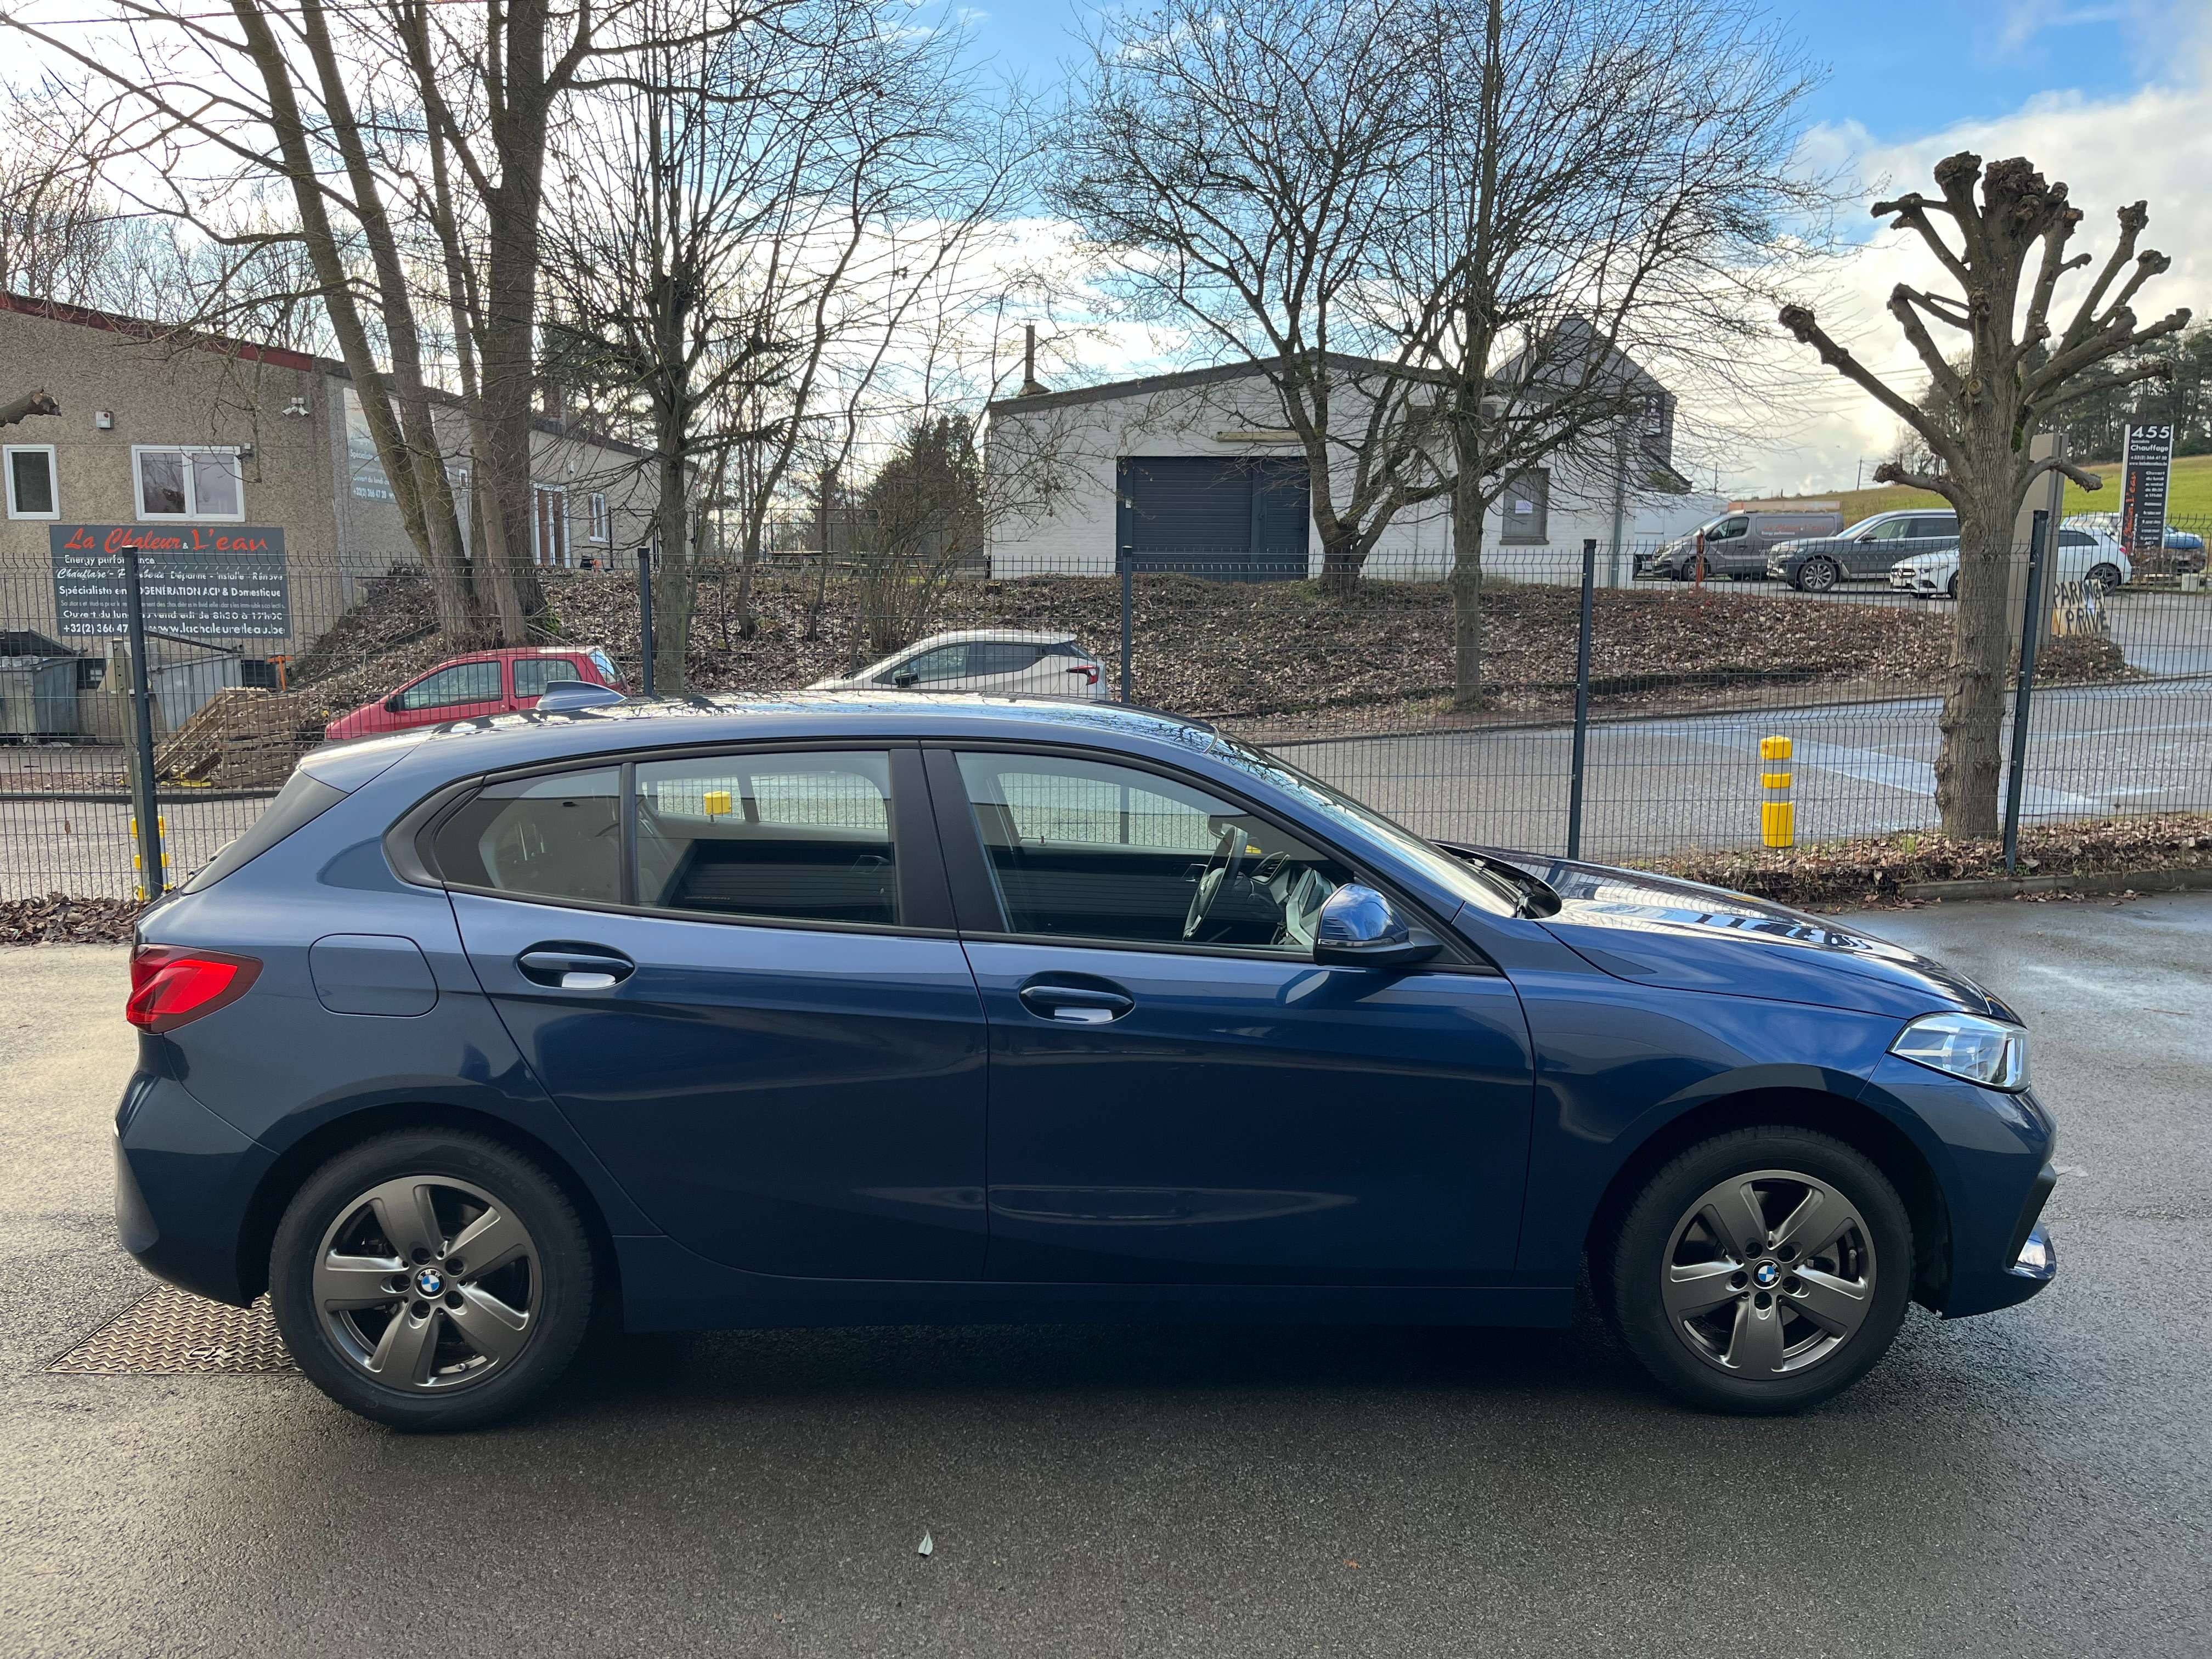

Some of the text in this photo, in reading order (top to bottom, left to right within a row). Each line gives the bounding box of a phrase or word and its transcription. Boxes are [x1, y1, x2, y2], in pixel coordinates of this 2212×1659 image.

[2131, 426, 2170, 439] 455
[2130, 444, 2169, 453] Chauffage
[367, 488, 375, 498] 366
[375, 489, 381, 498] 47
[64, 528, 95, 549] La
[105, 528, 181, 553] Chaleur
[191, 528, 268, 551] L'eau
[65, 555, 94, 566] Energy
[59, 585, 112, 596] Spécialiste
[222, 588, 228, 596] &
[231, 588, 281, 599] Domestique
[64, 623, 94, 635] +32(2)
[97, 624, 114, 633] 366
[117, 624, 128, 633] 47
[417, 1270, 441, 1281] BMW
